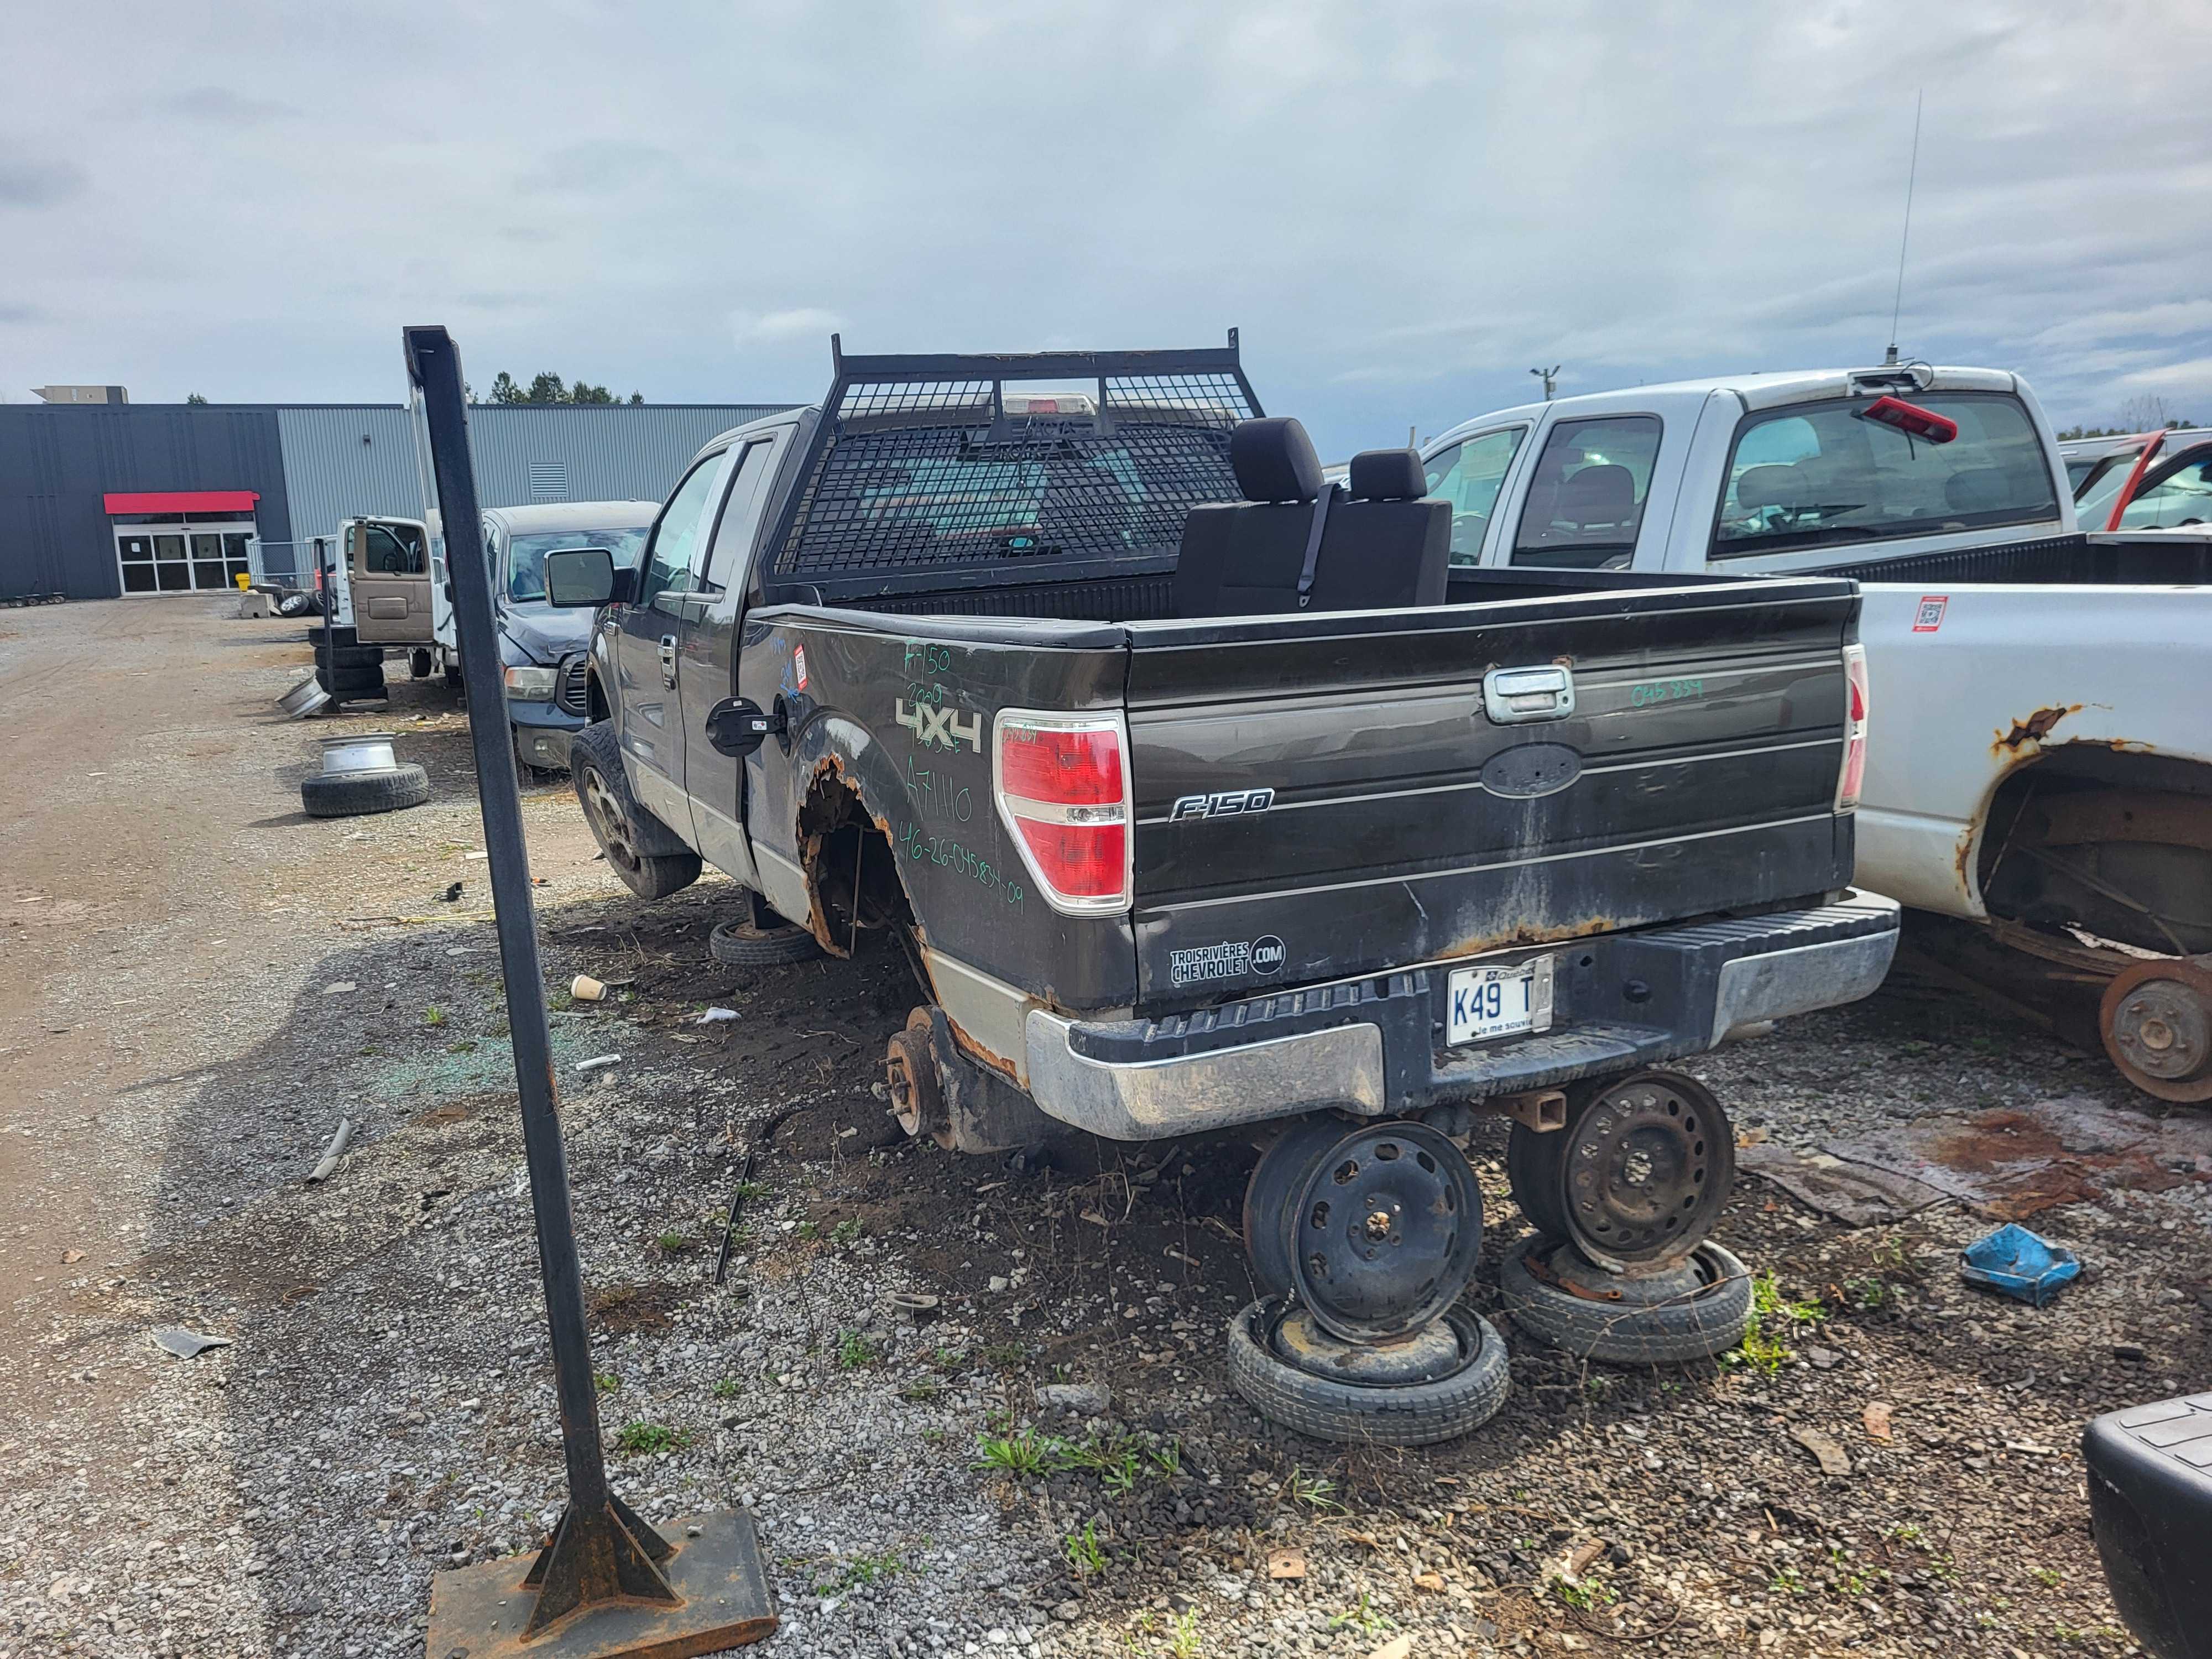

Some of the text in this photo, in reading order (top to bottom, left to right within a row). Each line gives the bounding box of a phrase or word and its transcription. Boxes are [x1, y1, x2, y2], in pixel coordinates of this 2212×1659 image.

[1168, 787, 1275, 823] F-150
[1170, 941, 1282, 965] TROISRIVIÈRES .COM
[1172, 956, 1248, 984] CHEVROLET
[1453, 983, 1501, 1026] K49
